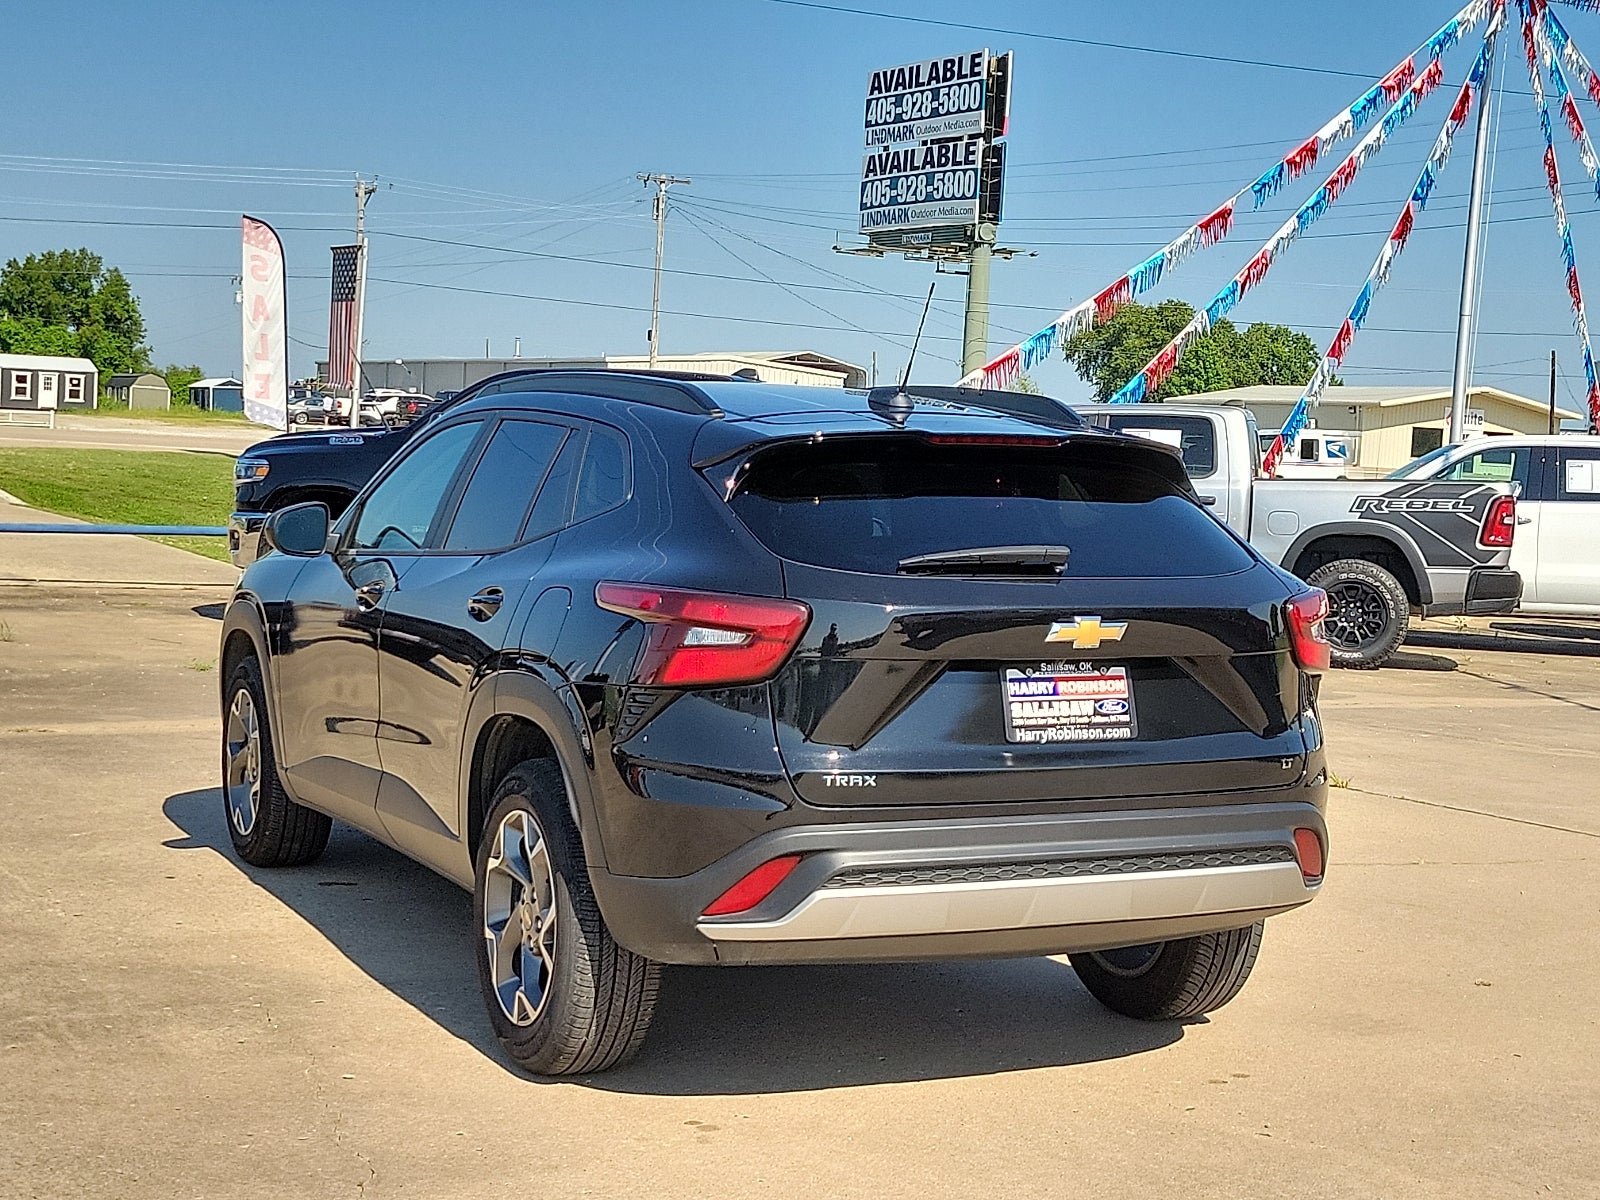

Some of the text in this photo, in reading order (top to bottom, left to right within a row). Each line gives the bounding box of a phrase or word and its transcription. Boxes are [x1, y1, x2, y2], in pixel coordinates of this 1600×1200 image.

[869, 52, 983, 97] AVAILABLE
[867, 82, 981, 125] 405-928-5800
[865, 119, 980, 146] LINDMARK Outdoor Media.com
[864, 141, 977, 179] AVAILABLE
[862, 170, 976, 208] 405-928-5800
[861, 205, 974, 229] LINDMARK Outdoor Media.com
[1349, 496, 1476, 513] REBEL
[1040, 662, 1077, 674] Sallisaw,
[1079, 662, 1093, 671] OK
[1009, 680, 1126, 696] HARRY ROBINSON
[1016, 727, 1131, 743] HarryRobinson.com
[822, 775, 877, 787] TRAX
